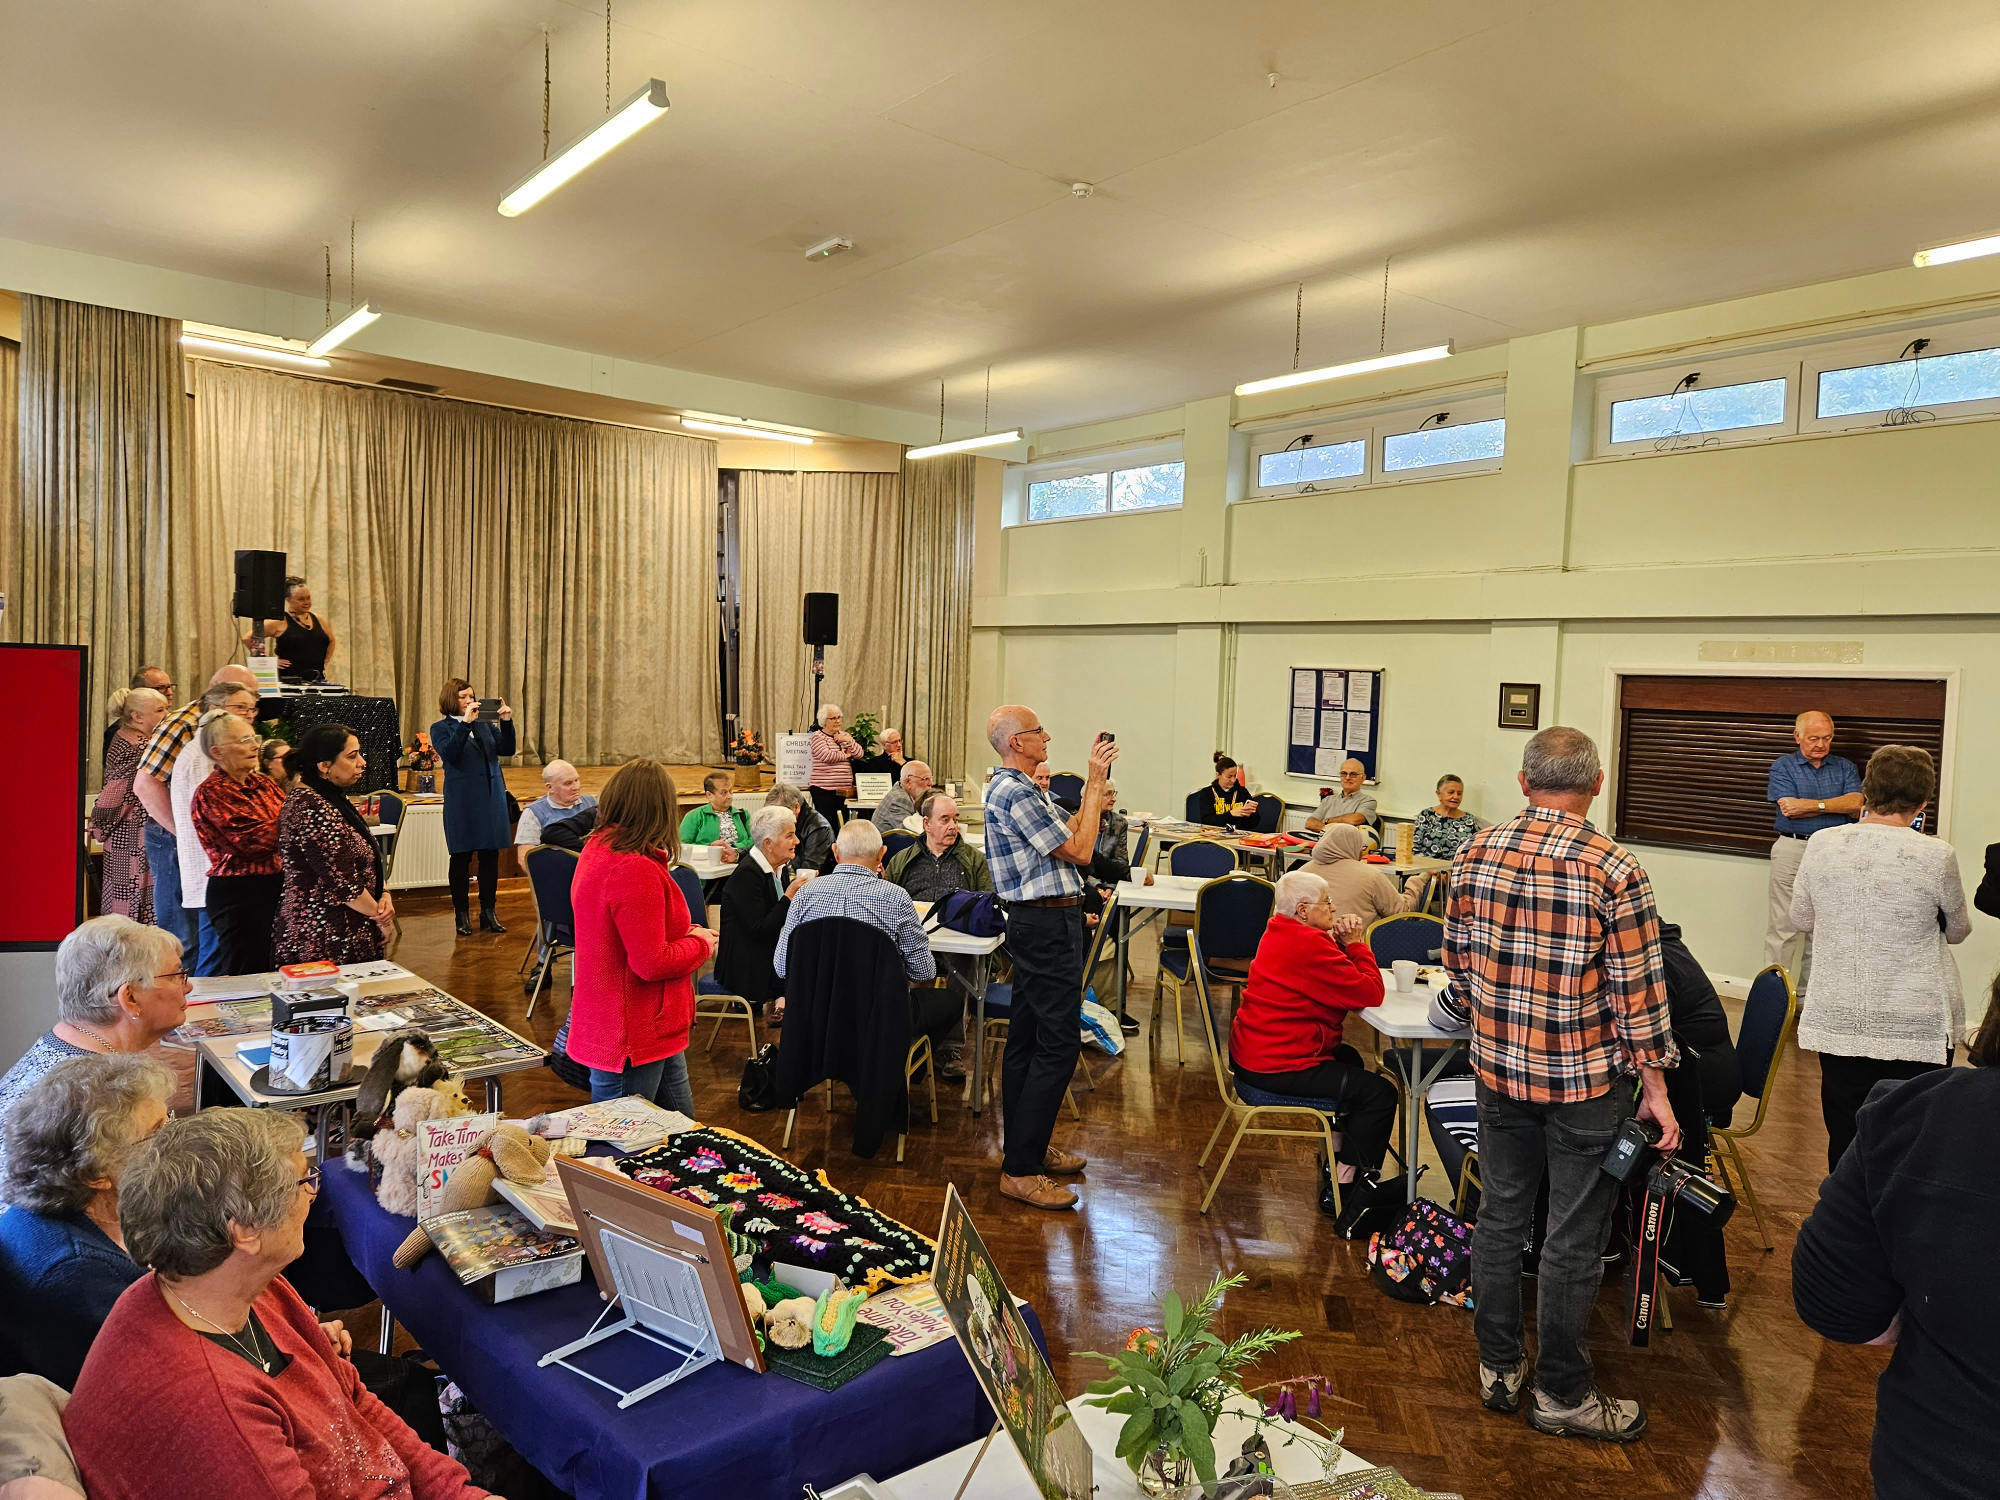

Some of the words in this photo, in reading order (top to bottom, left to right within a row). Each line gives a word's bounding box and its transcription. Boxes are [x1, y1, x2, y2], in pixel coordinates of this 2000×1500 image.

[428, 1130, 455, 1149] Take
[427, 1150, 463, 1169] Makes
[422, 1209, 470, 1225] Together
[1646, 1202, 1659, 1242] Canon
[880, 1297, 912, 1316] You
[1636, 1293, 1651, 1330] Canon
[903, 1308, 949, 1333] Makes
[1351, 1475, 1374, 1484] CONTACT
[1374, 1470, 1393, 1478] PLEASE
